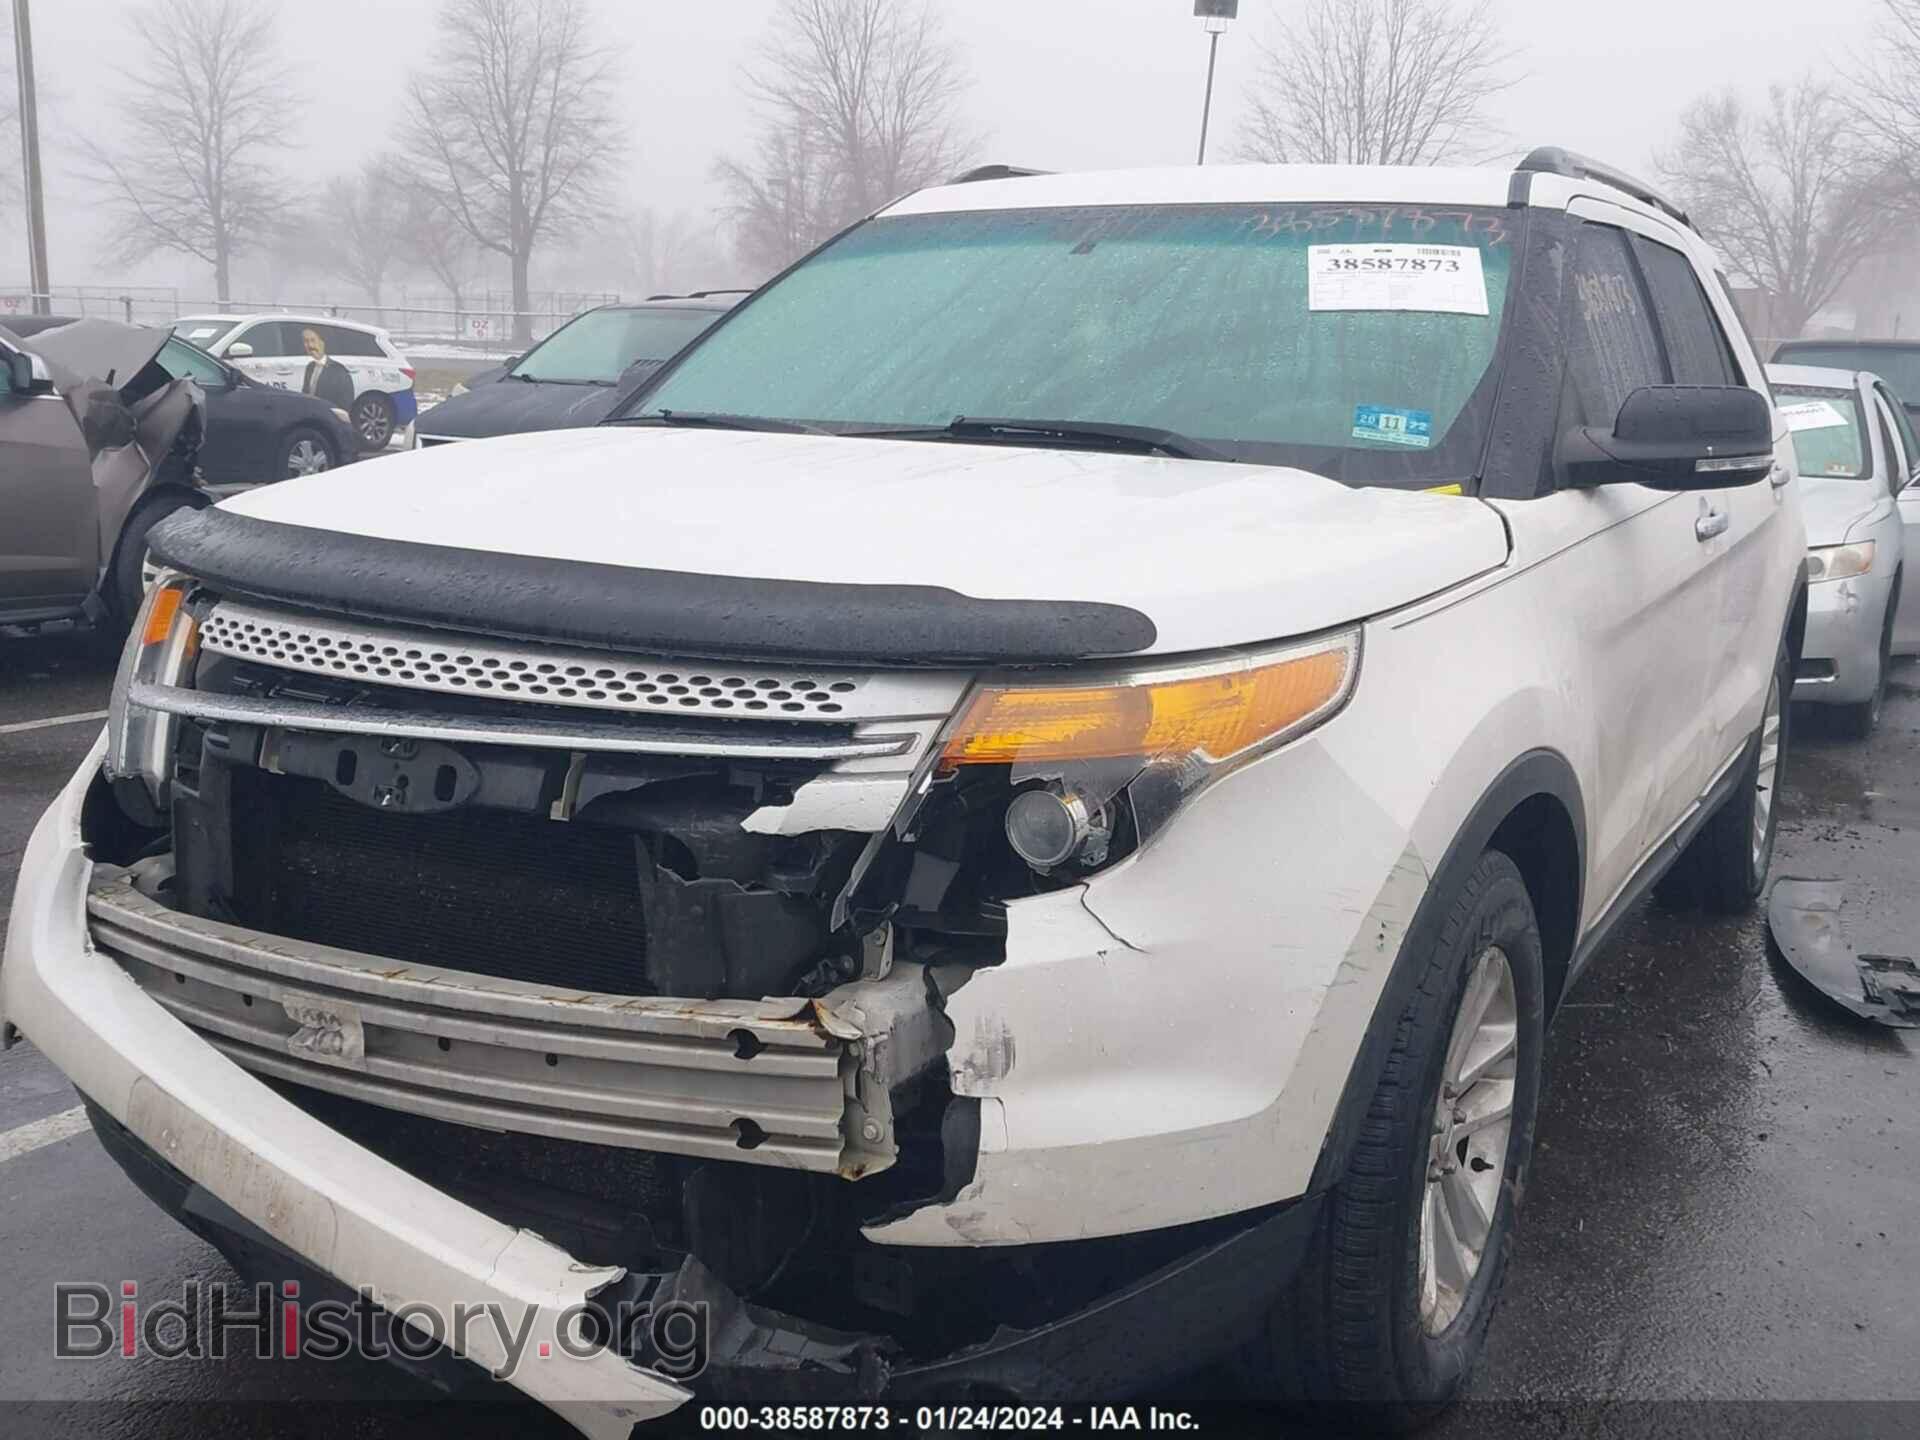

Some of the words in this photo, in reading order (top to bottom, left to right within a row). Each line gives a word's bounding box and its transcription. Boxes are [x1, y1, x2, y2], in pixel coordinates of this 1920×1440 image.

[1327, 258, 1461, 273] 38587873
[1359, 414, 1376, 424] 20
[1383, 416, 1401, 430] 11
